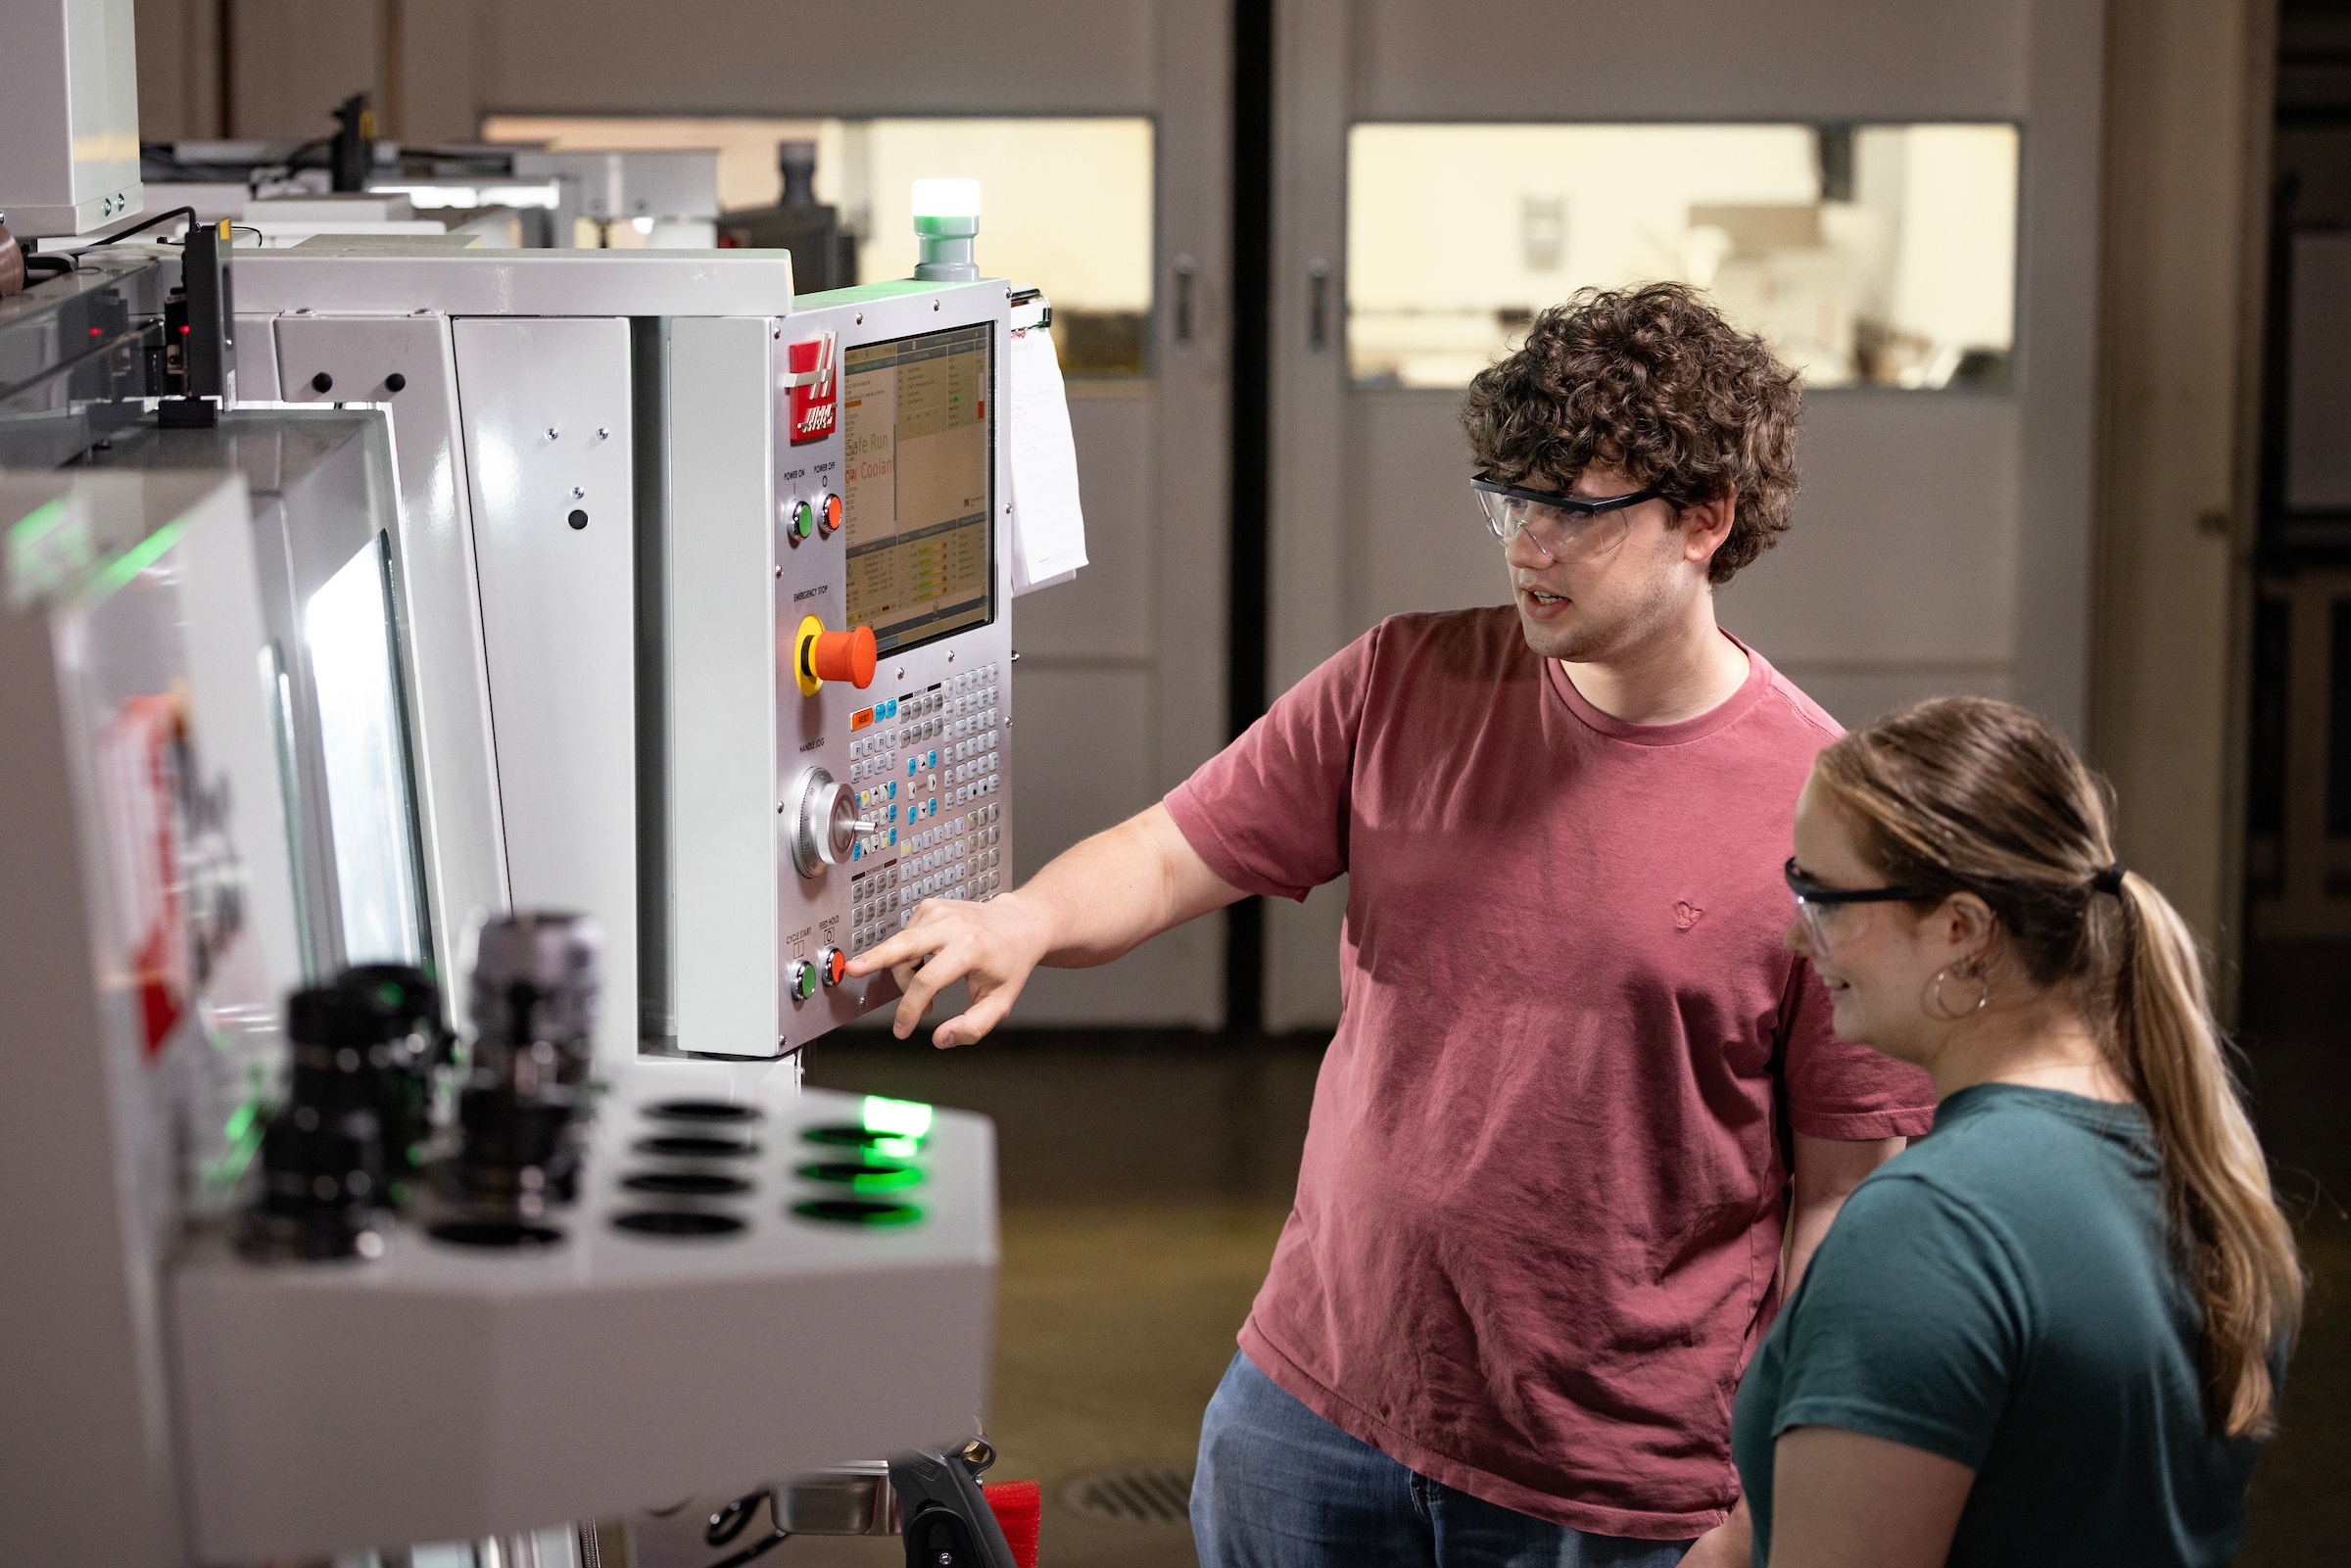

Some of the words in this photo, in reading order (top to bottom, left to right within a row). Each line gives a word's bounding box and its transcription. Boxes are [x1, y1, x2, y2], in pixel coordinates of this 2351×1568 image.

[871, 434, 888, 451] Run
[785, 470, 797, 480] POWER
[798, 469, 805, 477] ON
[814, 463, 827, 474] POWER
[794, 588, 817, 602] EMERGENCY
[818, 585, 827, 595] STOP
[858, 713, 870, 724] RESET
[800, 741, 815, 753] HANDLE
[816, 738, 824, 748] JOG
[819, 920, 828, 930] FEED
[829, 915, 839, 926] HOLD
[787, 932, 799, 944] CYCLE
[800, 927, 811, 939] START
